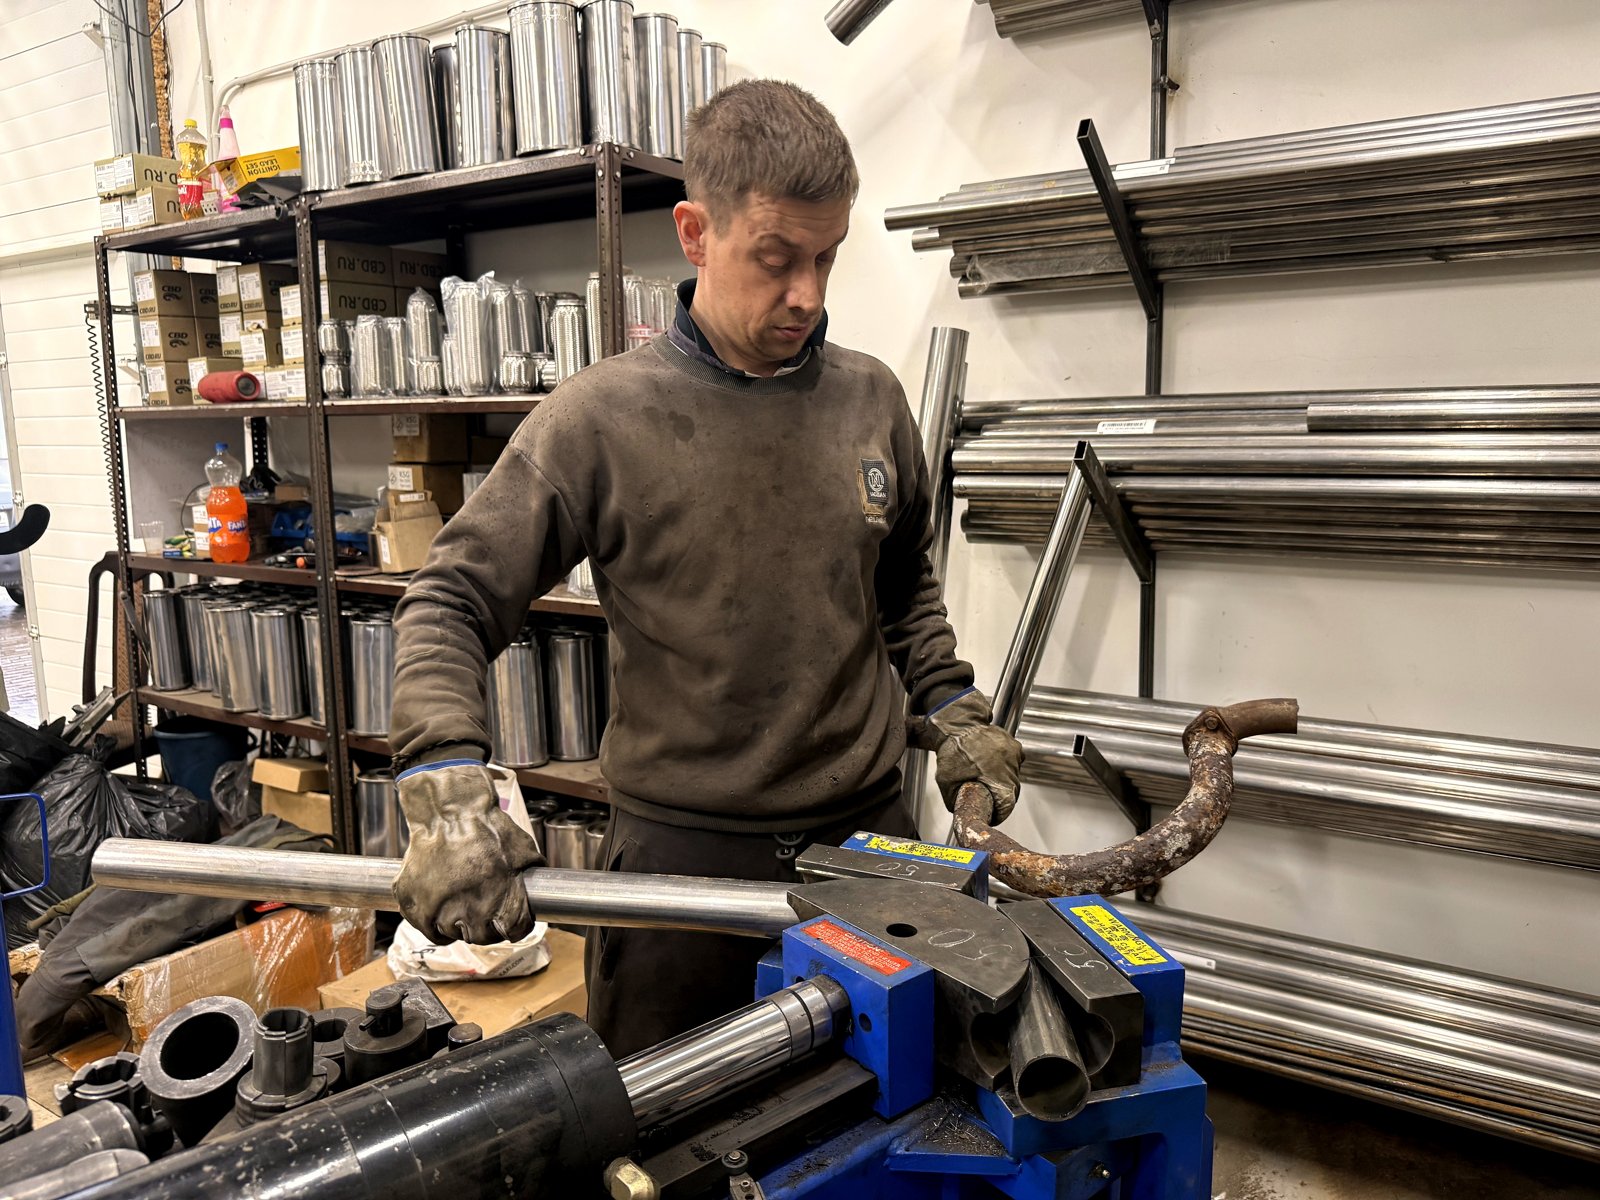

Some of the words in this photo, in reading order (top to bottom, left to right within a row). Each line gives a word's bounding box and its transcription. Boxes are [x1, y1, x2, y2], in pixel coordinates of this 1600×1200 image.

[245, 162, 259, 171] SET
[259, 158, 278, 167] LEAD
[248, 164, 281, 177] IGNITION
[337, 256, 386, 274] CBD.RU
[162, 285, 182, 293] CBD
[338, 295, 387, 312] CBD.RU
[140, 306, 156, 314] CBD.RU
[1081, 909, 1100, 923] KEEP
[1098, 922, 1122, 941] HANDS
